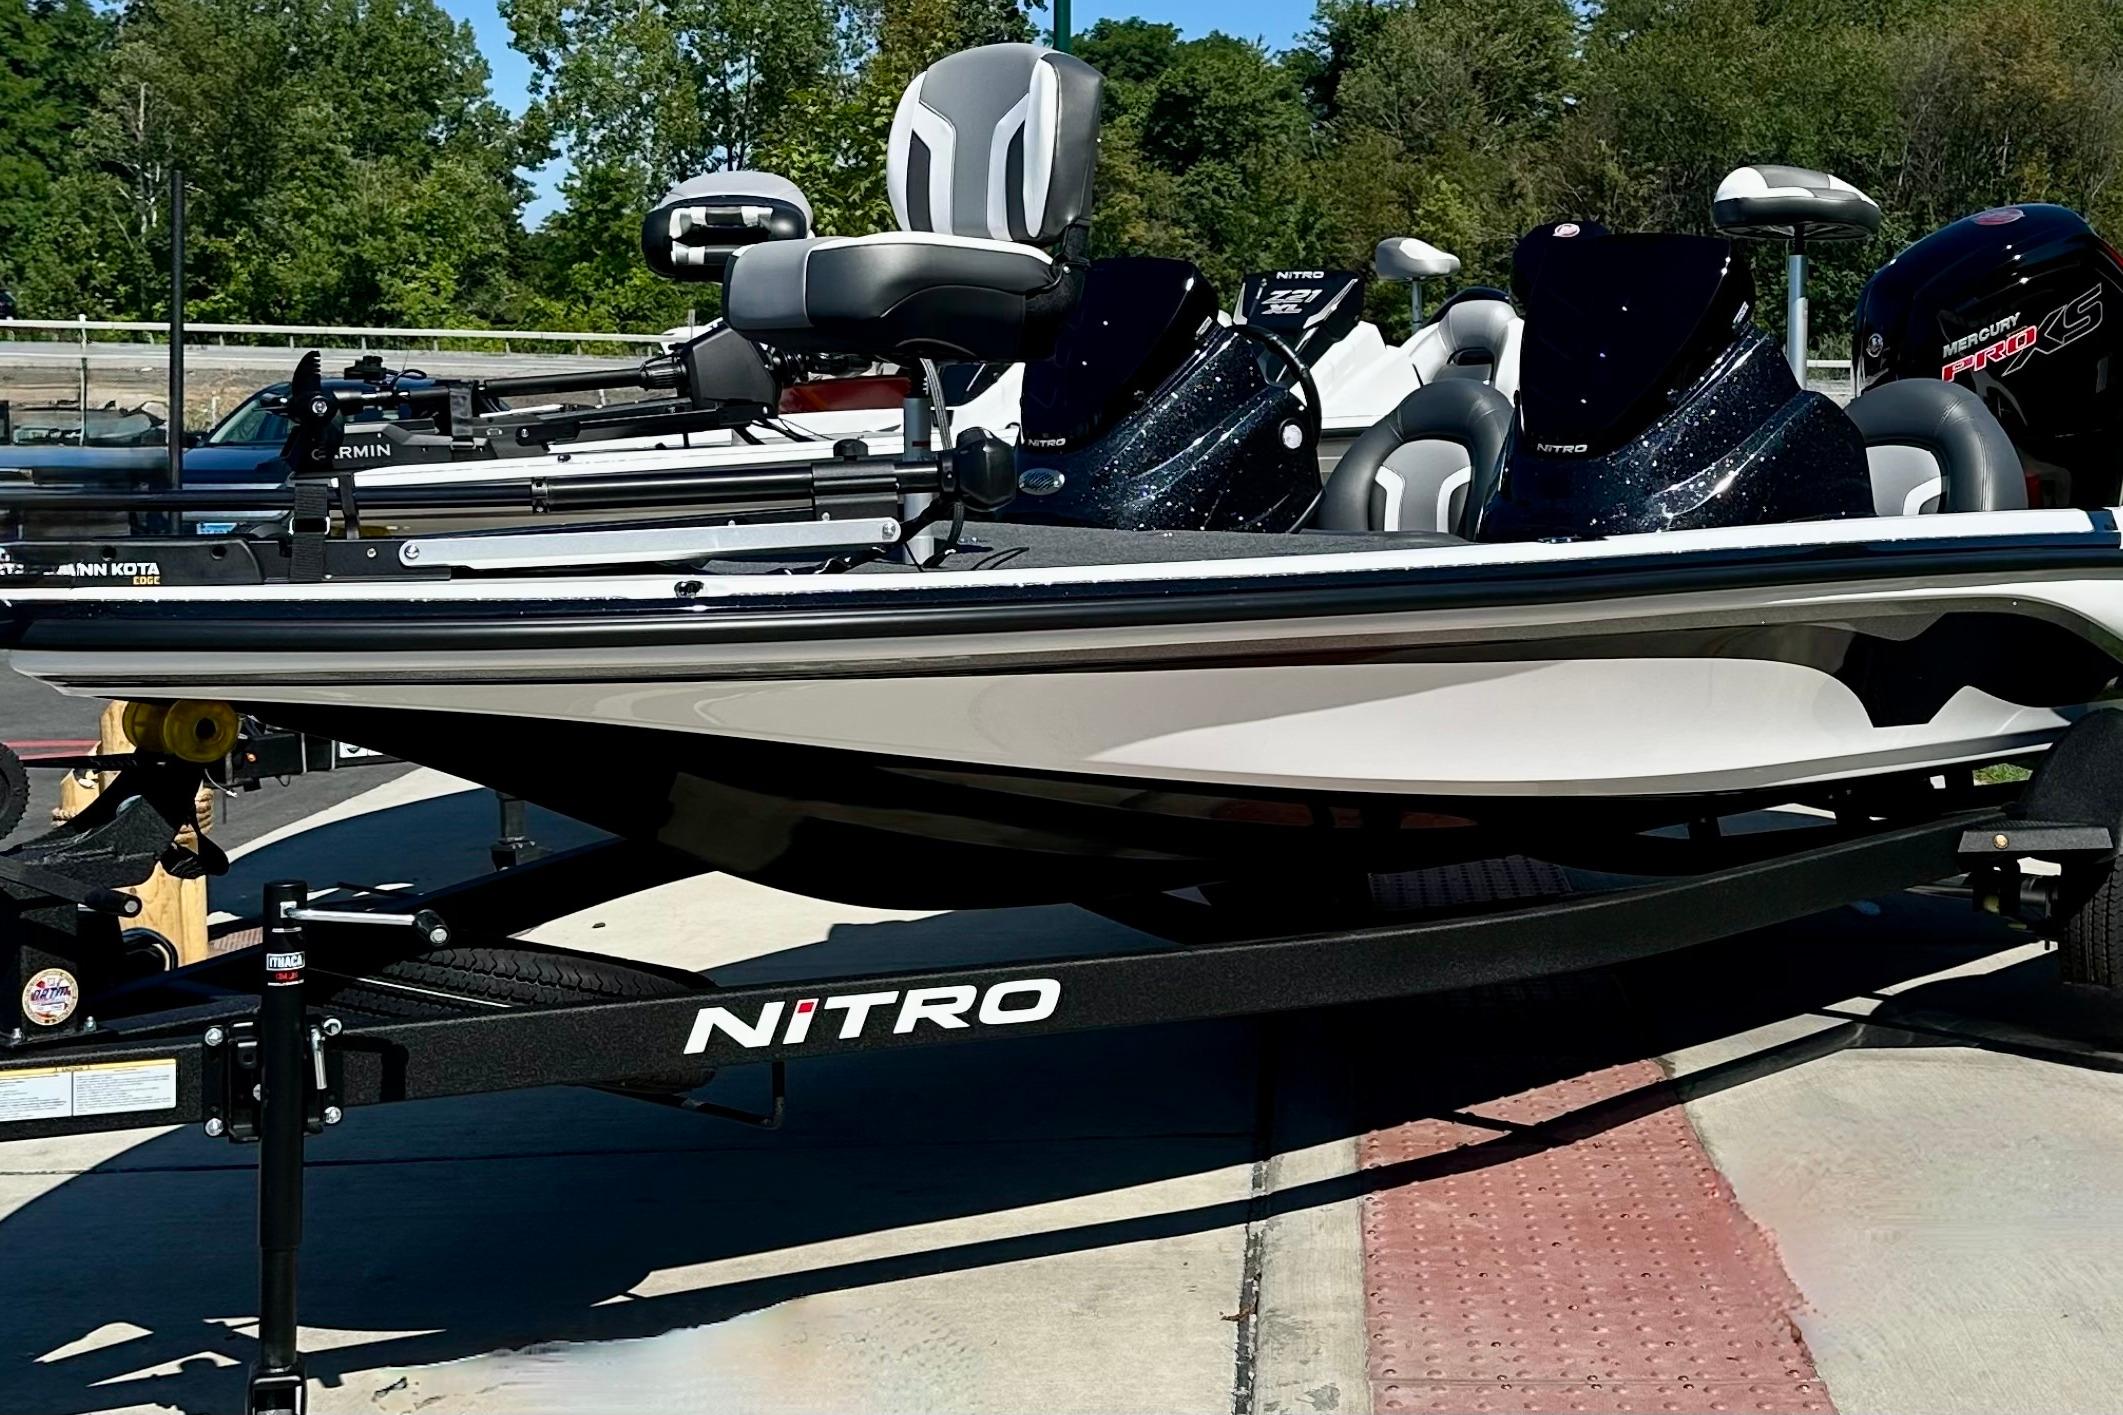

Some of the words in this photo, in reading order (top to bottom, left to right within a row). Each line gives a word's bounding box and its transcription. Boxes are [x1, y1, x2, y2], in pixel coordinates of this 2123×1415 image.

[1276, 271, 1325, 279] NITRO
[1261, 289, 1323, 304] Z21
[1261, 303, 1303, 315] XL
[1942, 311, 2021, 358] MERCURY
[1941, 325, 2038, 383] PRO
[311, 443, 391, 460] GRMIN
[1536, 443, 1588, 453] NITRO
[111, 562, 161, 576] KOTA
[133, 576, 161, 585] EDGE
[270, 955, 303, 968] ITHACA
[683, 978, 1061, 1055] NITRO
